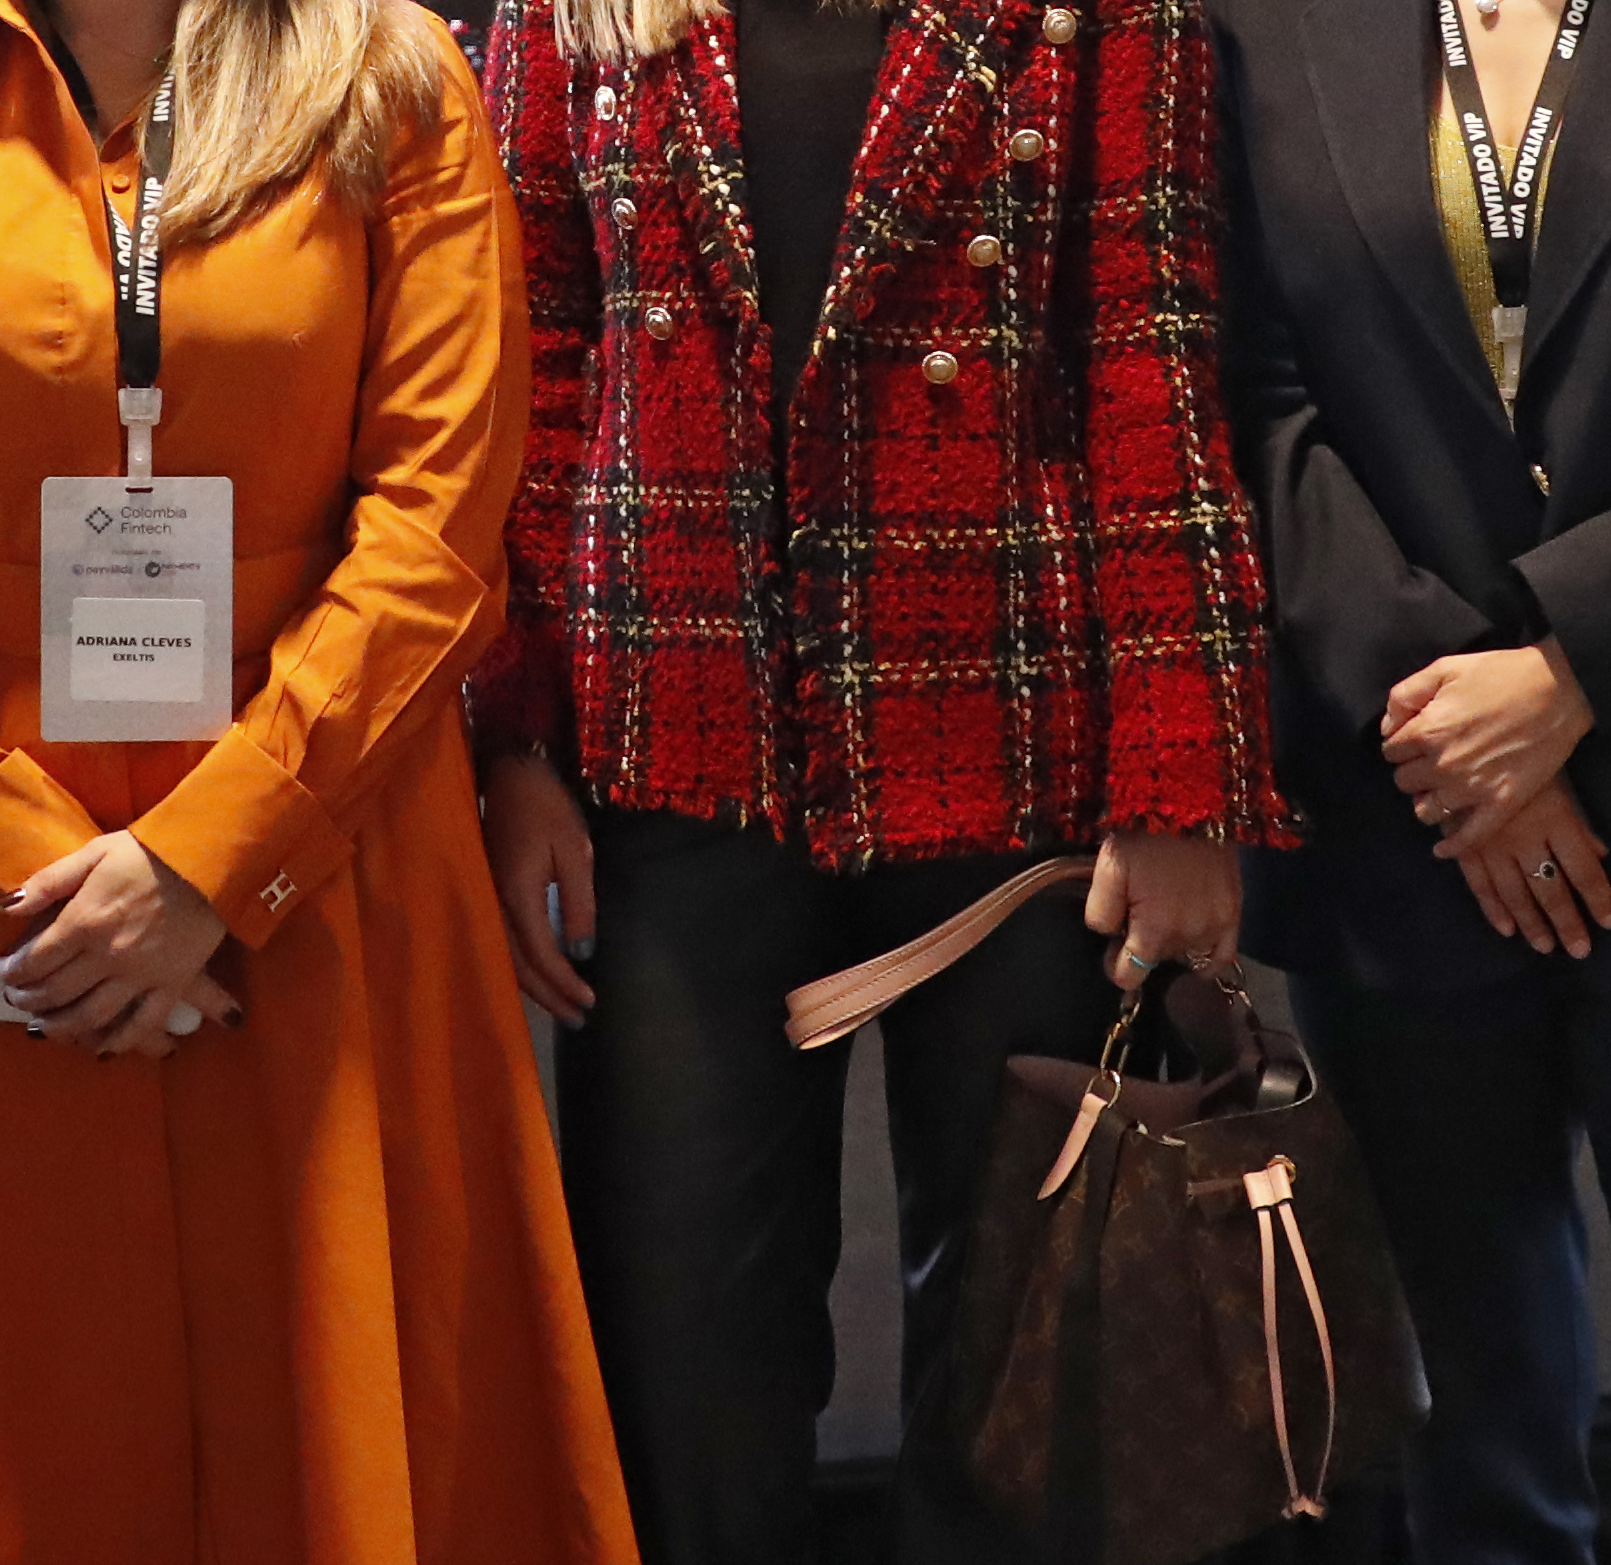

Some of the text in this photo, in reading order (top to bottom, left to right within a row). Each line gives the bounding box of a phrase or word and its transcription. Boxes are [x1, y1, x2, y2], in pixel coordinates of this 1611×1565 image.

[1557, 28, 1576, 60] VIP
[1511, 107, 1552, 198] INVITADO
[1463, 112, 1510, 239] INVITADO VIP
[135, 176, 165, 316] INVITADO VIP
[120, 506, 188, 520] Colombia
[120, 522, 172, 535] Fintech
[76, 636, 192, 648] ADRIANA CLEVES
[113, 653, 155, 662] EXELTIS
